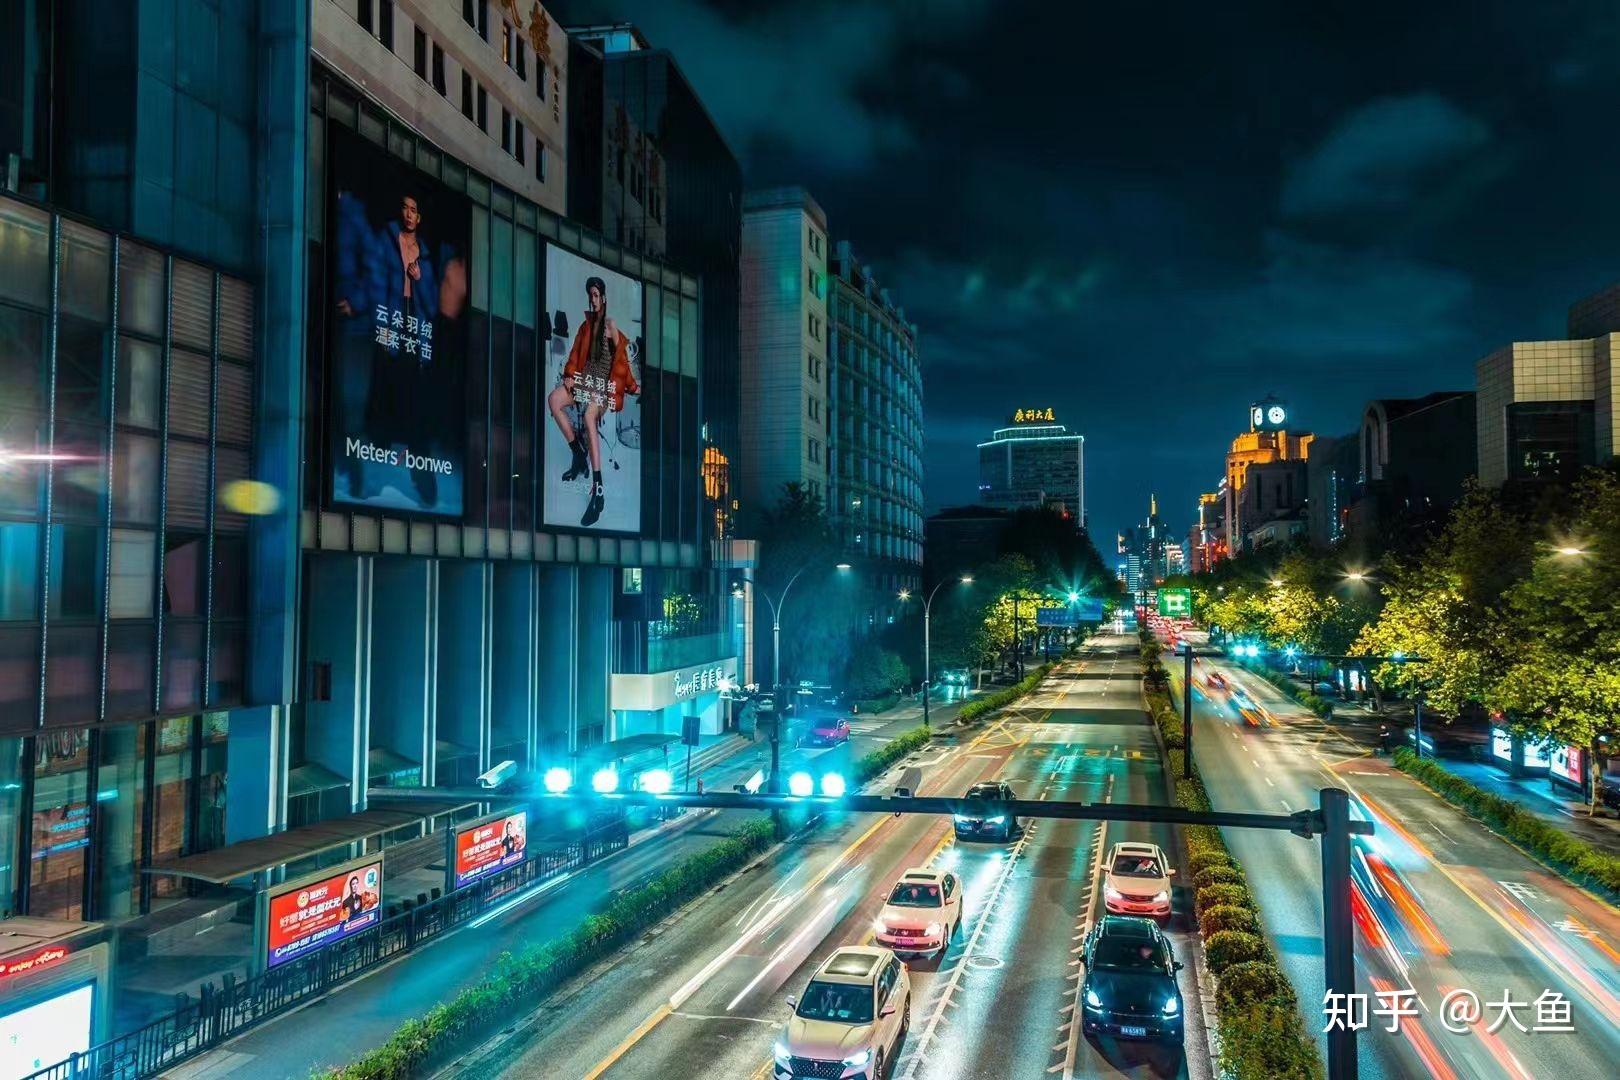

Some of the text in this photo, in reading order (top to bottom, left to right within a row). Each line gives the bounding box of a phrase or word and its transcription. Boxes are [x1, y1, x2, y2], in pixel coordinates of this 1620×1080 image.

[376, 304, 433, 340] 云朵羽绒
[573, 371, 617, 395] 云朵羽绒
